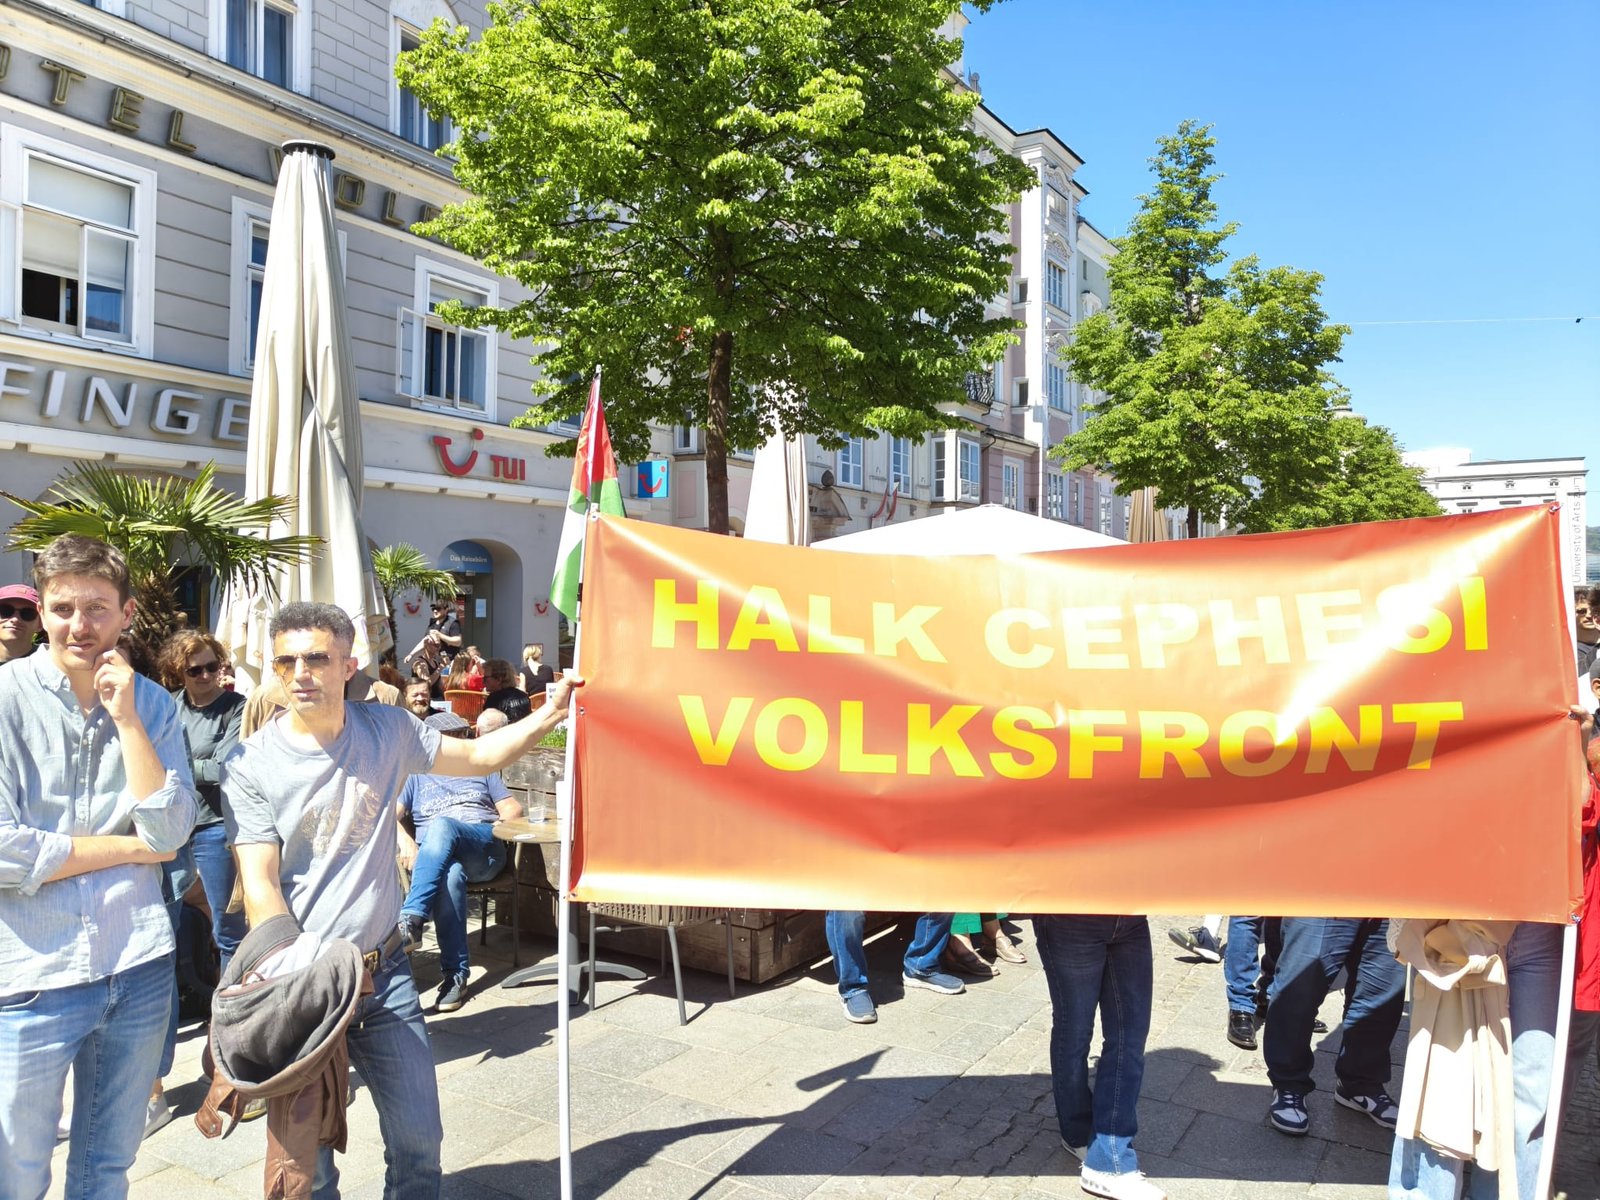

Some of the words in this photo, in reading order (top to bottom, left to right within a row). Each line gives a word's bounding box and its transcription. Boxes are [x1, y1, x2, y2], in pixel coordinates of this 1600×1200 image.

[490, 454, 526, 481] TUI
[1572, 501, 1582, 522] Arts
[1572, 523, 1582, 534] of
[1572, 535, 1582, 583] University
[651, 578, 948, 663] HALK
[984, 576, 1488, 669] CEPHESI
[677, 695, 1464, 780] VOLKSFRONT
